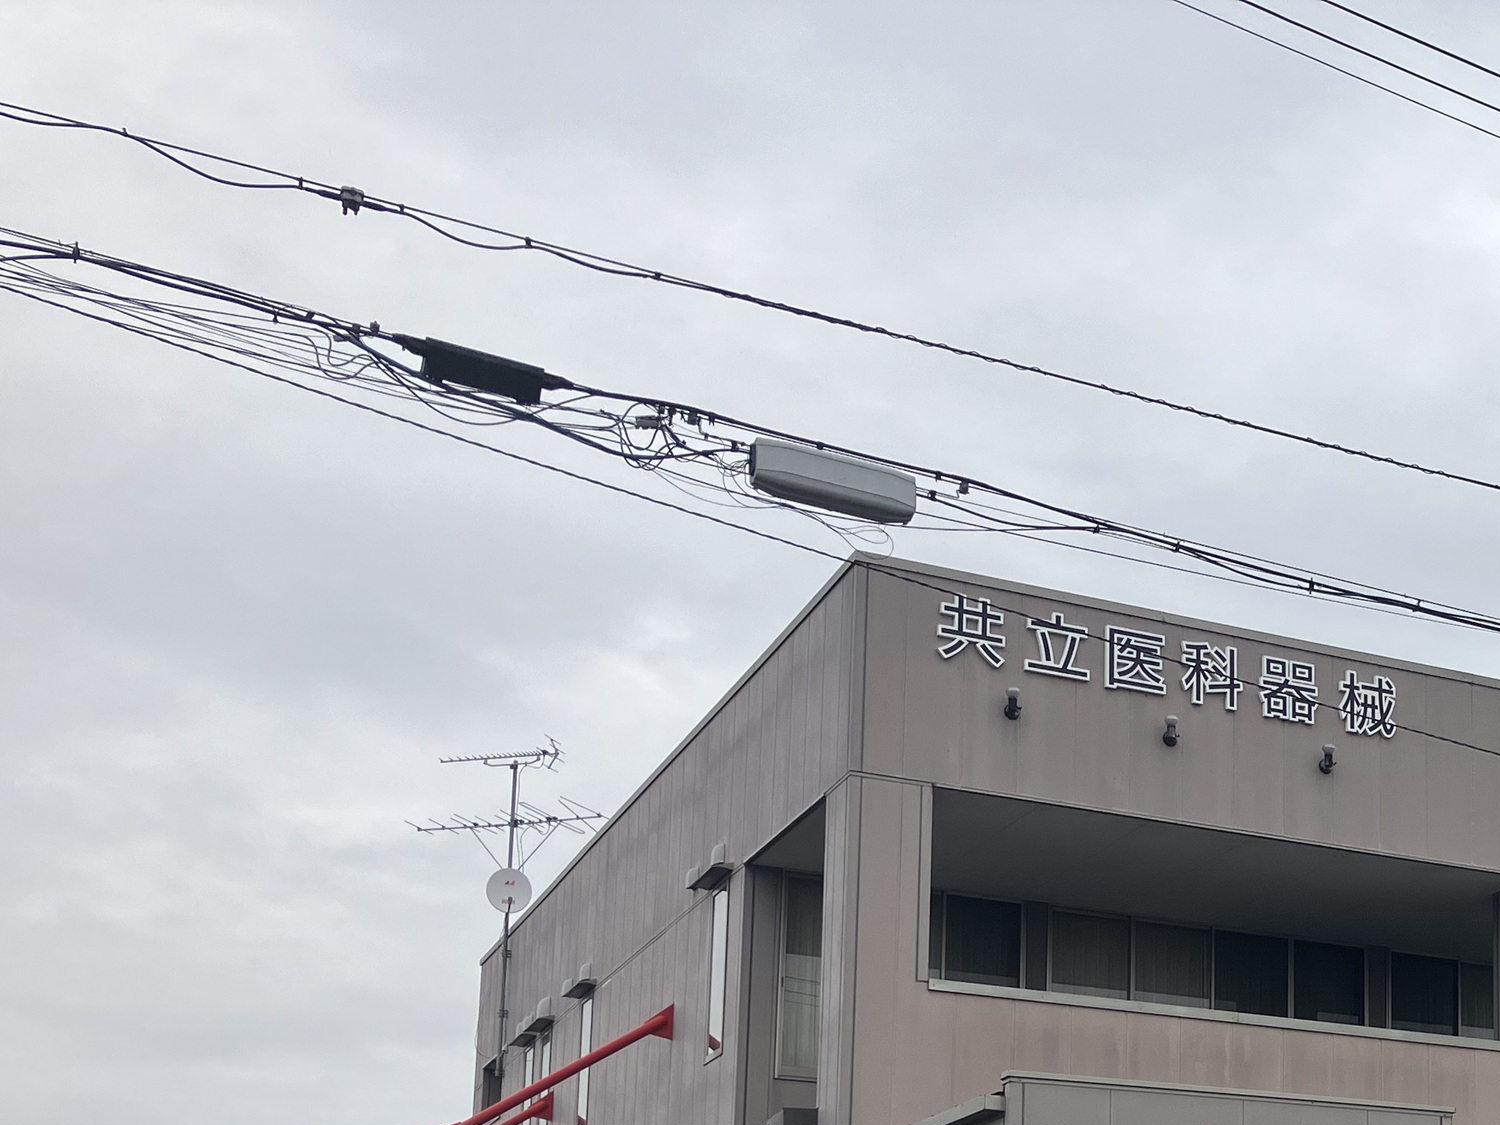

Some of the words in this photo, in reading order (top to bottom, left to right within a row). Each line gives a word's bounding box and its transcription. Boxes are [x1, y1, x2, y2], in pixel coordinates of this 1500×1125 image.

[936, 594, 1397, 738] 共立医科器械
